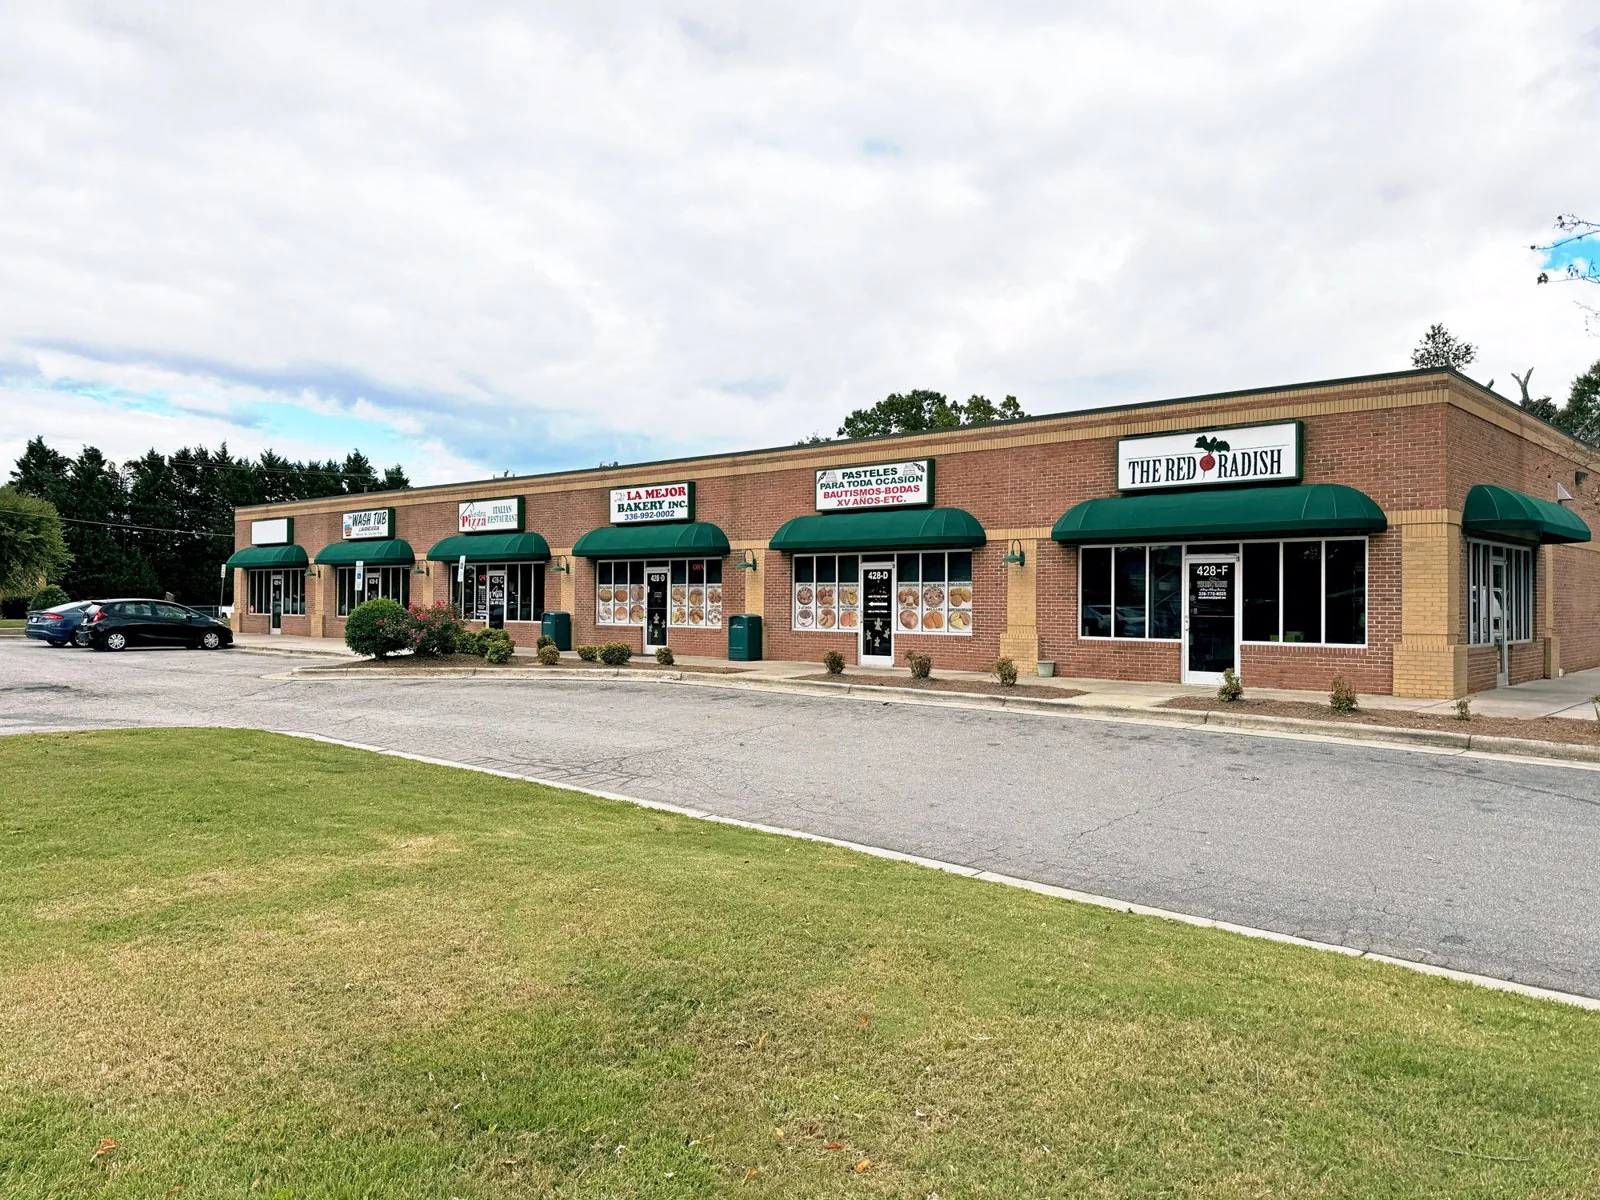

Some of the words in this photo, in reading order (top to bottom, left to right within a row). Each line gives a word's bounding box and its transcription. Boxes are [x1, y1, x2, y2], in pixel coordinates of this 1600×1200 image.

[842, 467, 898, 480] PASTELES
[1128, 459, 1162, 485] THE
[1165, 456, 1197, 482] RED
[1217, 449, 1283, 478] RADISH
[820, 481, 845, 490] PARA
[846, 479, 873, 488] TODA
[875, 475, 923, 486] OCASION
[626, 491, 642, 501] LA
[645, 486, 687, 500] MEJOR
[823, 484, 920, 499] BAUTISMOS-BODAS
[617, 500, 665, 513] BAKERY
[668, 500, 688, 509] INC.
[837, 499, 850, 507] XV
[492, 505, 512, 515] ITALIAN
[624, 510, 675, 521] 336-992-0002
[352, 512, 372, 527] WASH
[373, 511, 387, 526] TUB
[461, 515, 487, 528] Pizza
[487, 513, 518, 524] RESTAURANT
[867, 571, 889, 580] 428-D
[1196, 565, 1229, 576] 428-F
